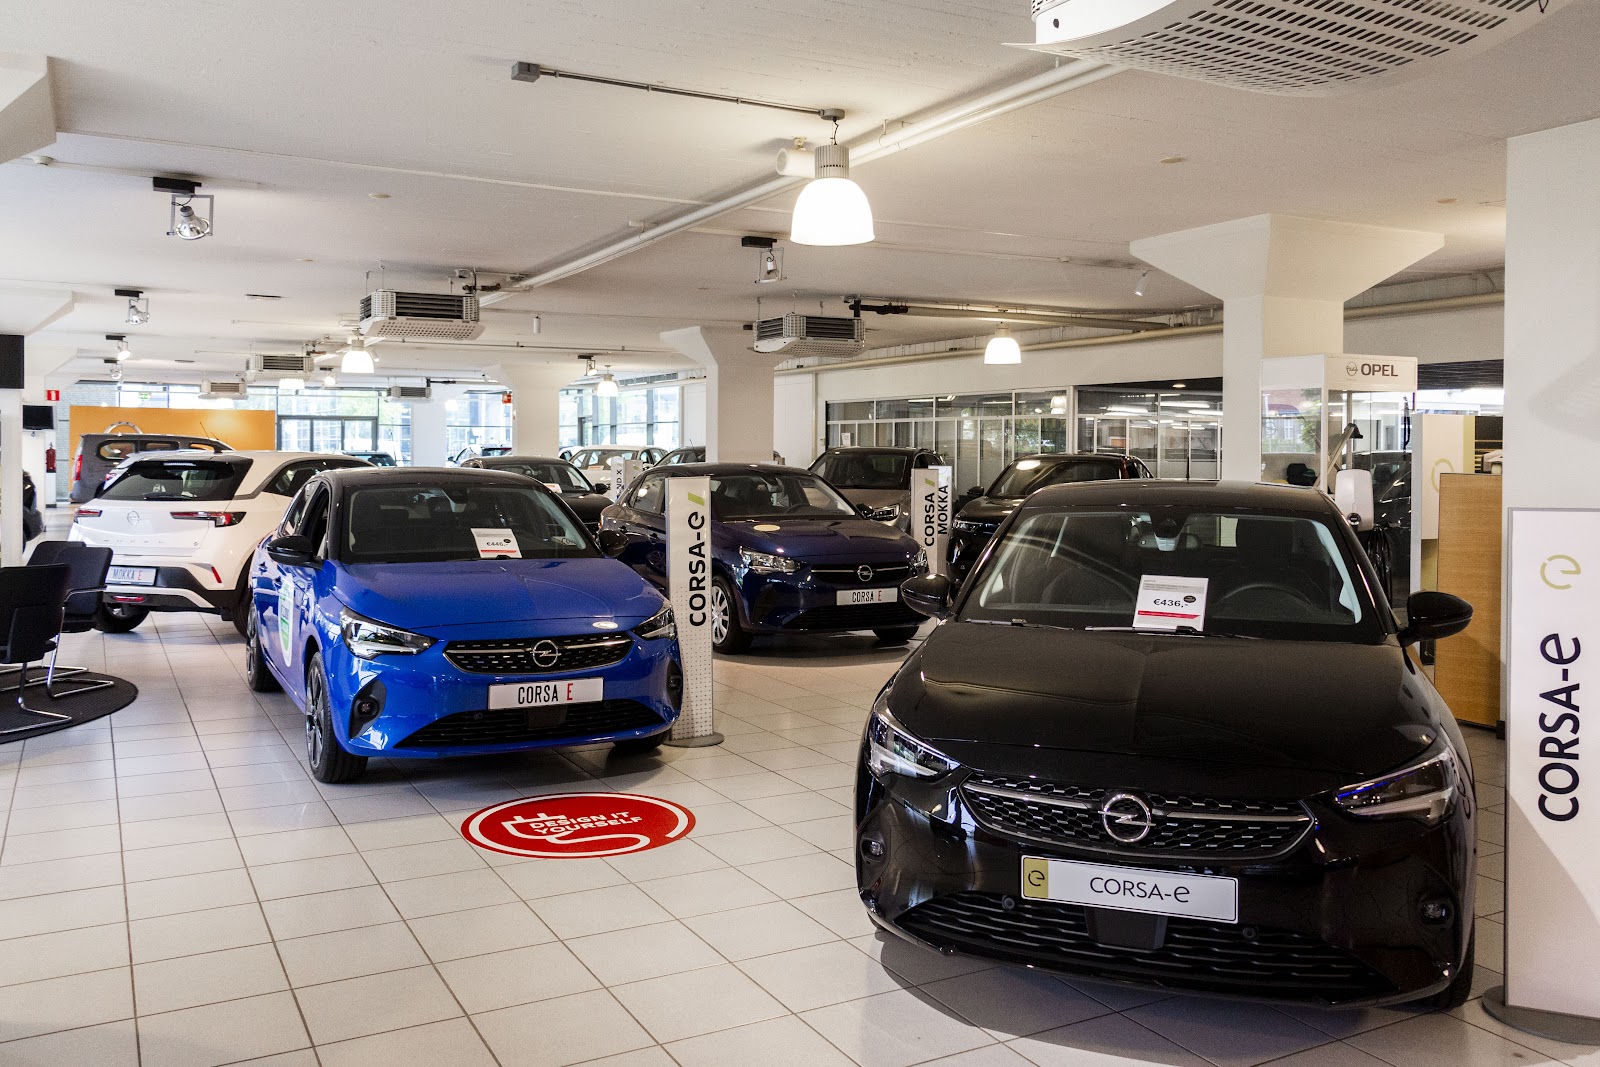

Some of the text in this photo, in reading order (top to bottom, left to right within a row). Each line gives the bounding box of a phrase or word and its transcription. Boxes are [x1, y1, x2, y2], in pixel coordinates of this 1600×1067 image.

[1361, 363, 1398, 377] OPEL
[924, 492, 935, 547] CORSA
[937, 485, 949, 535] MOKKA
[112, 568, 142, 581] MOKKA E
[688, 511, 706, 627] CORSA-e
[852, 590, 882, 603] CORSA E
[517, 682, 574, 705] CORSA E
[1537, 633, 1582, 822] CORSA-e
[529, 811, 630, 829] DESIGN IT
[534, 816, 642, 835] YOURSELF
[1089, 876, 1190, 903] CORSA-e
